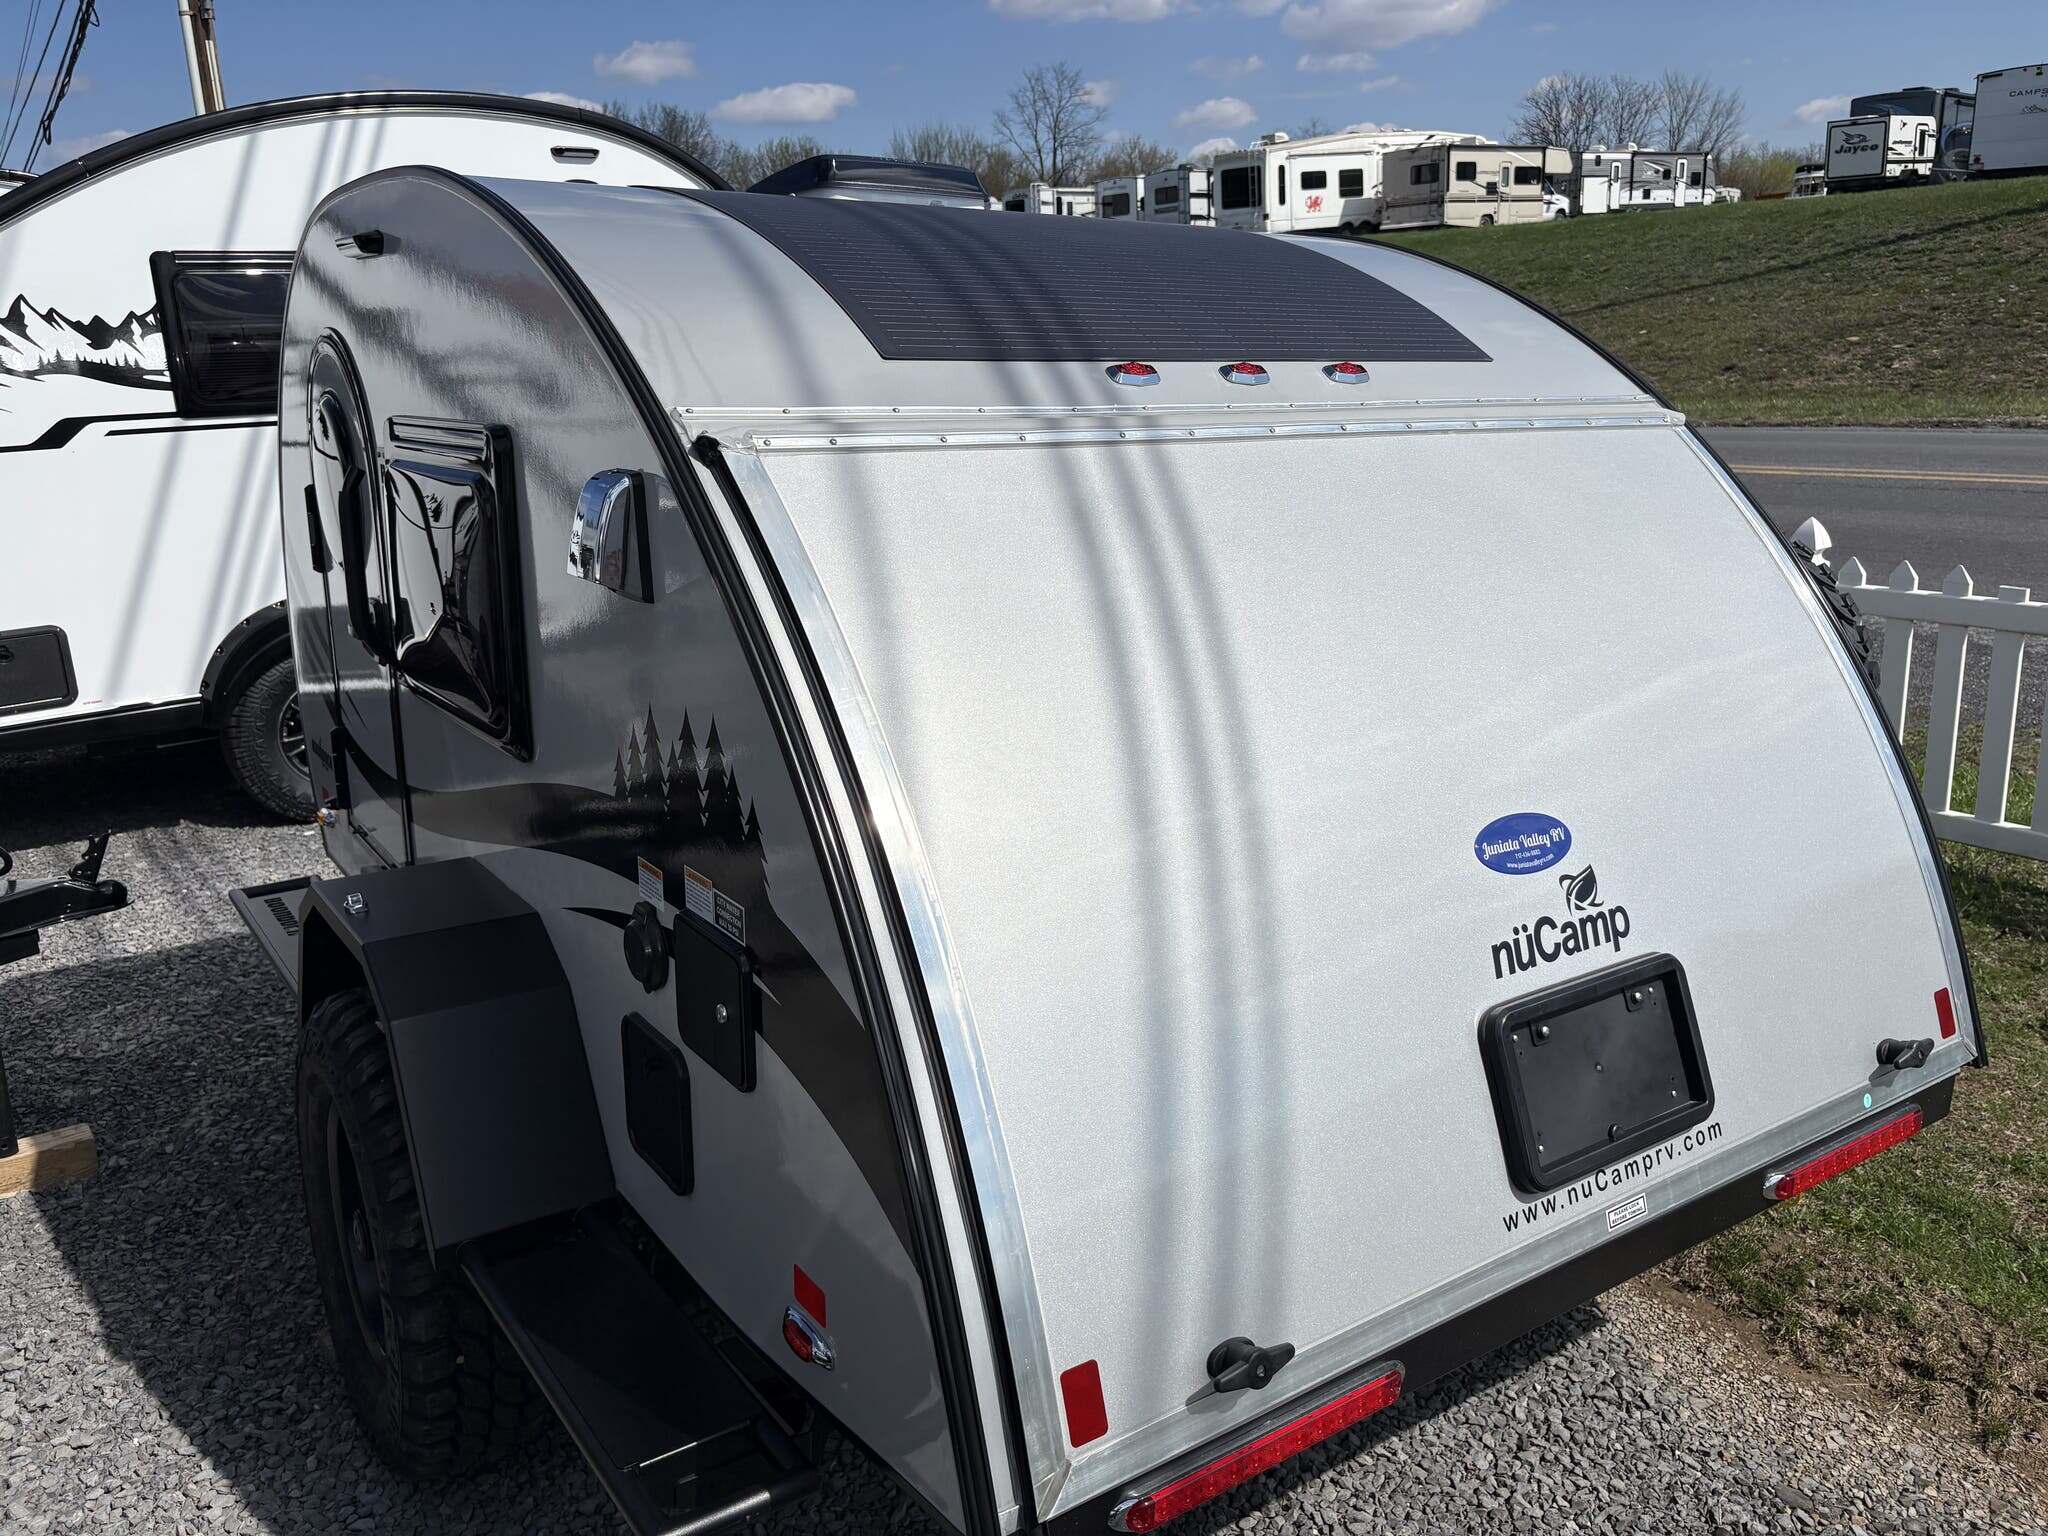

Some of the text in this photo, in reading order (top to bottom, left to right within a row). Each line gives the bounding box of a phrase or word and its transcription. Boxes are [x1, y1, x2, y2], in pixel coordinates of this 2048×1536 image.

[1835, 143, 1879, 155] Jayco
[1482, 826, 1566, 860] Juniata Valley RV
[1491, 905, 1630, 979] nüCamp
[1502, 1120, 1723, 1233] www.nuCamprv.com
